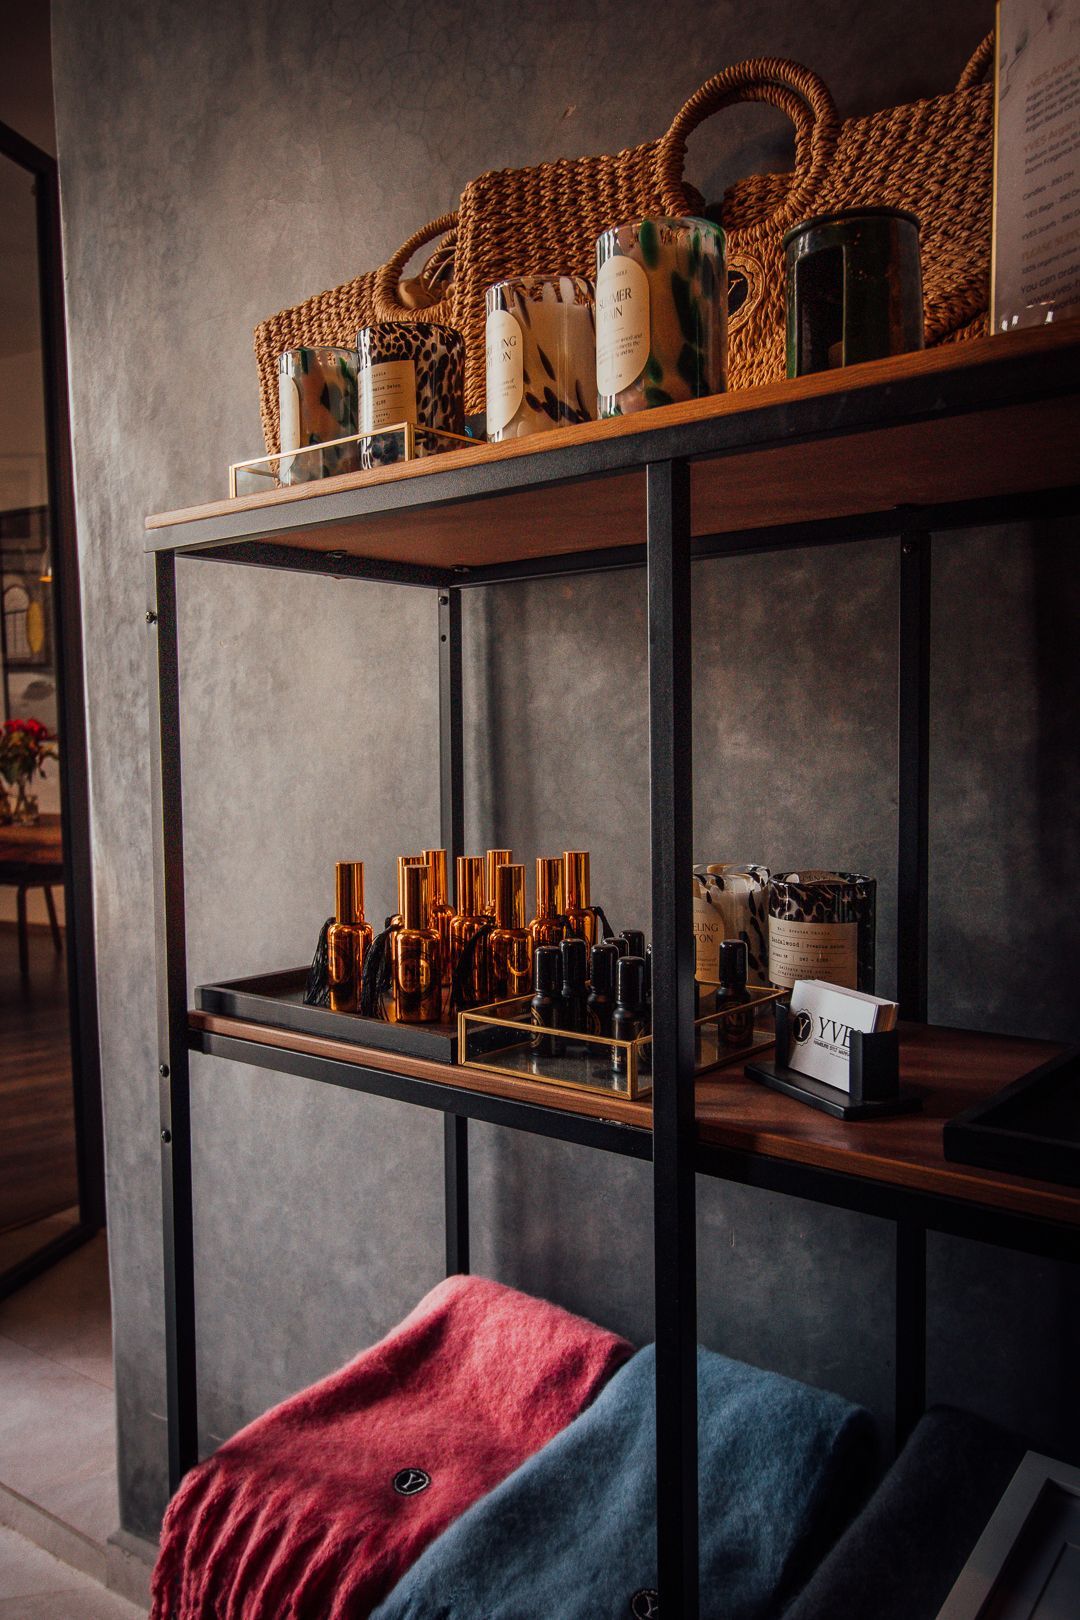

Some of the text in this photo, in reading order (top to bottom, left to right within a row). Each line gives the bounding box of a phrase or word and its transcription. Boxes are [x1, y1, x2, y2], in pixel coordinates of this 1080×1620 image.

[1020, 263, 1080, 295] You can orde
[798, 1016, 810, 1039] Y
[818, 1015, 857, 1049] YVE
[401, 1472, 424, 1489] Y
